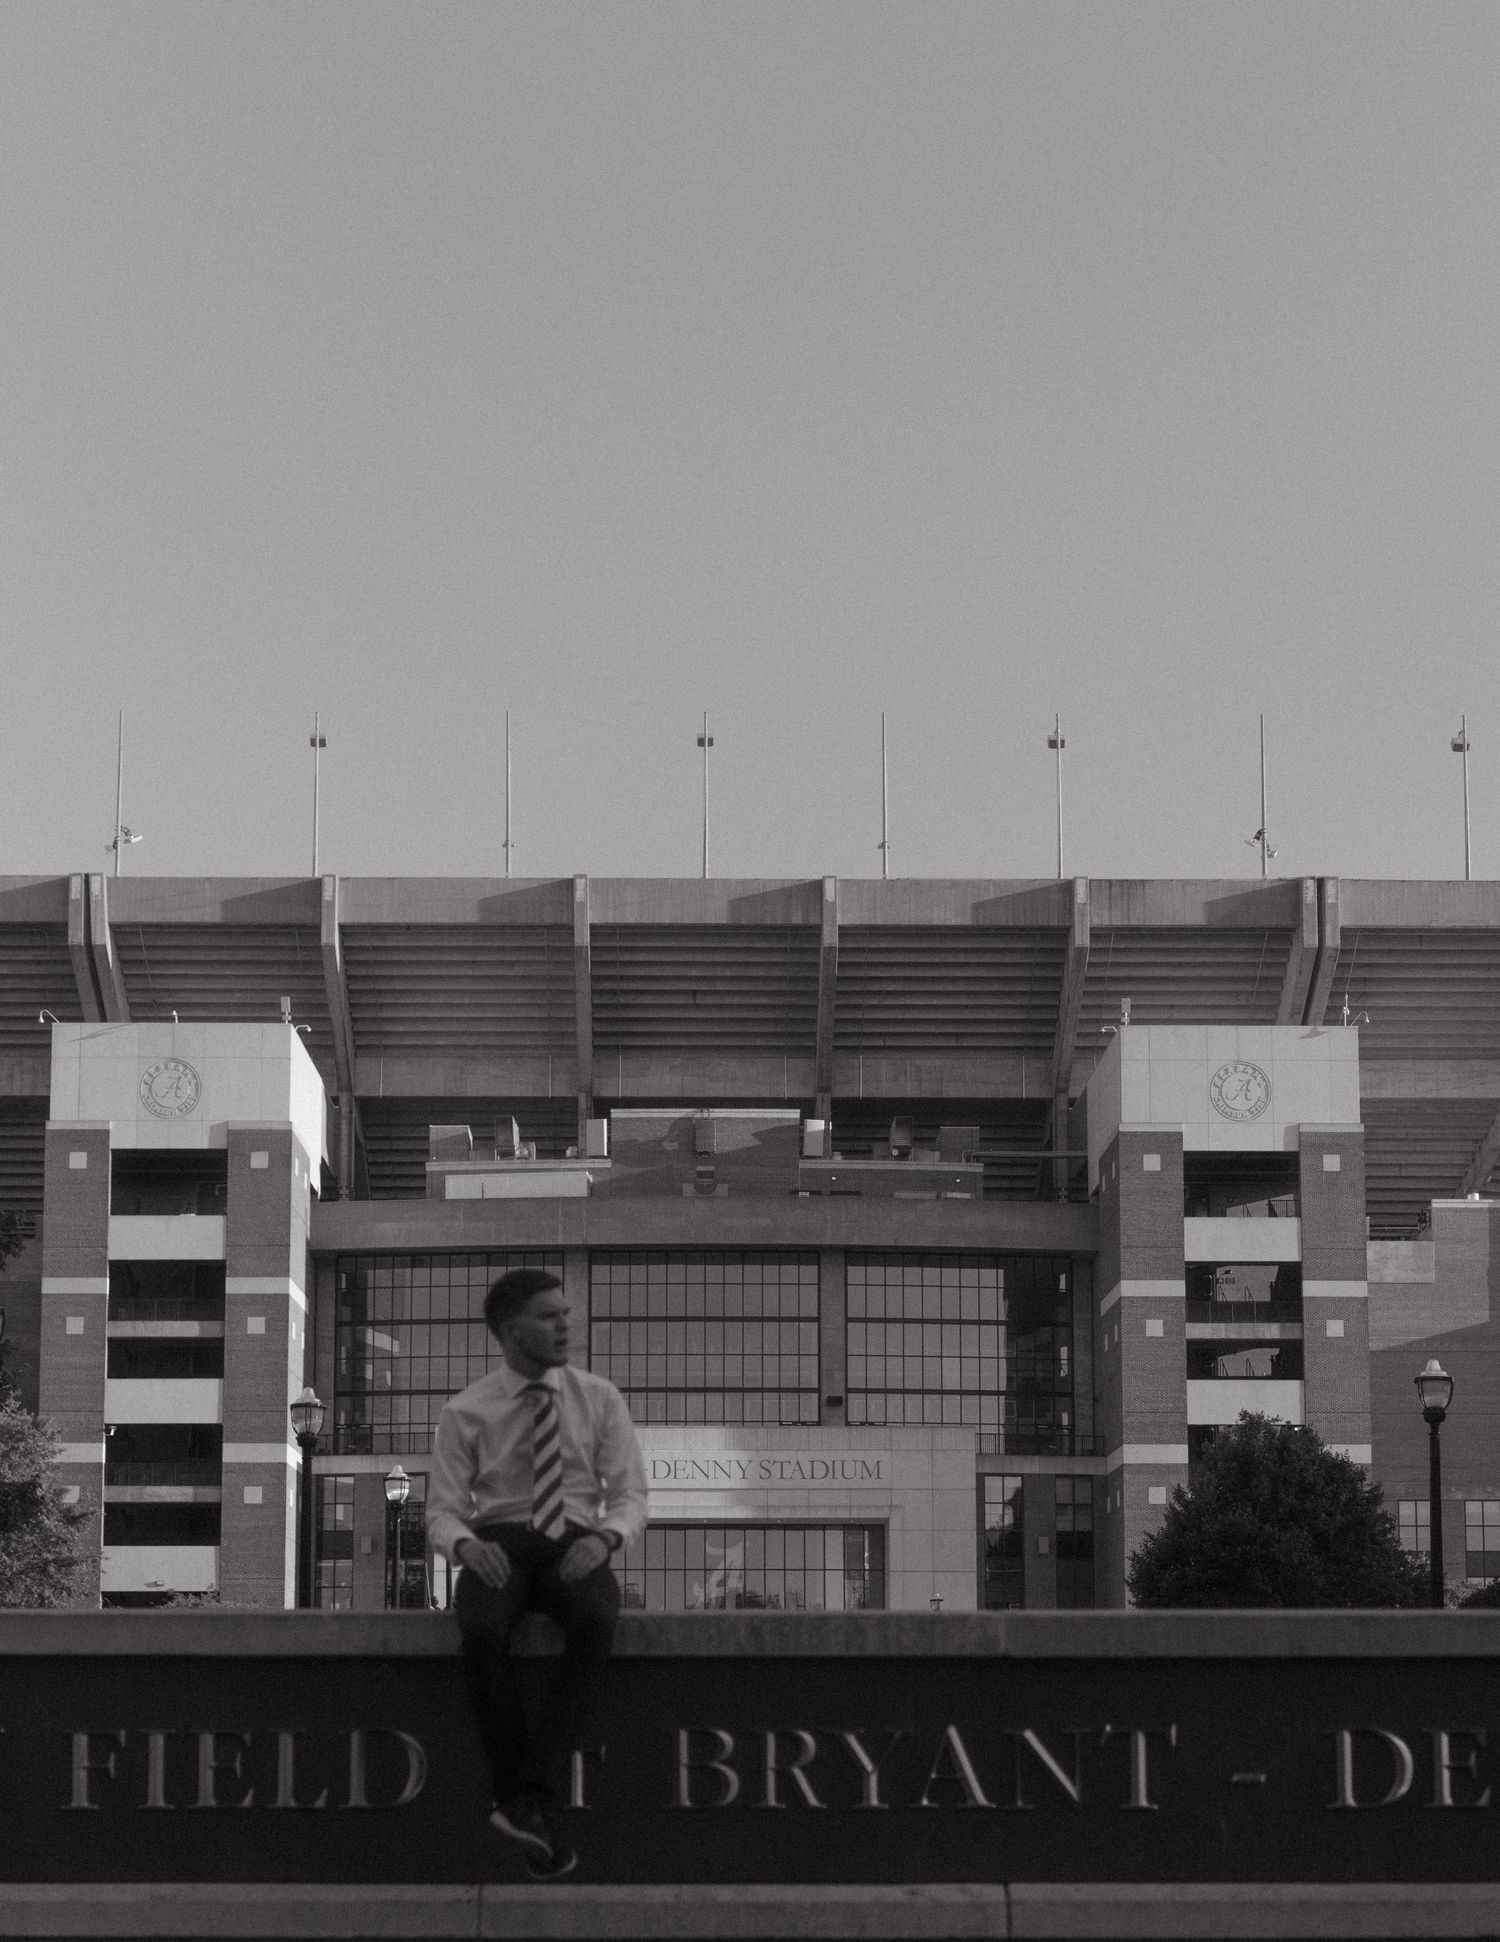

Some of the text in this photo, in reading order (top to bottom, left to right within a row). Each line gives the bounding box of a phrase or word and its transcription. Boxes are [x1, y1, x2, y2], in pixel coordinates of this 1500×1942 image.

[758, 1459, 883, 1480] STADIUM
[60, 1728, 428, 1809] FIELD
[662, 1723, 1178, 1810] BRYANT
[1324, 1727, 1492, 1808] DE
